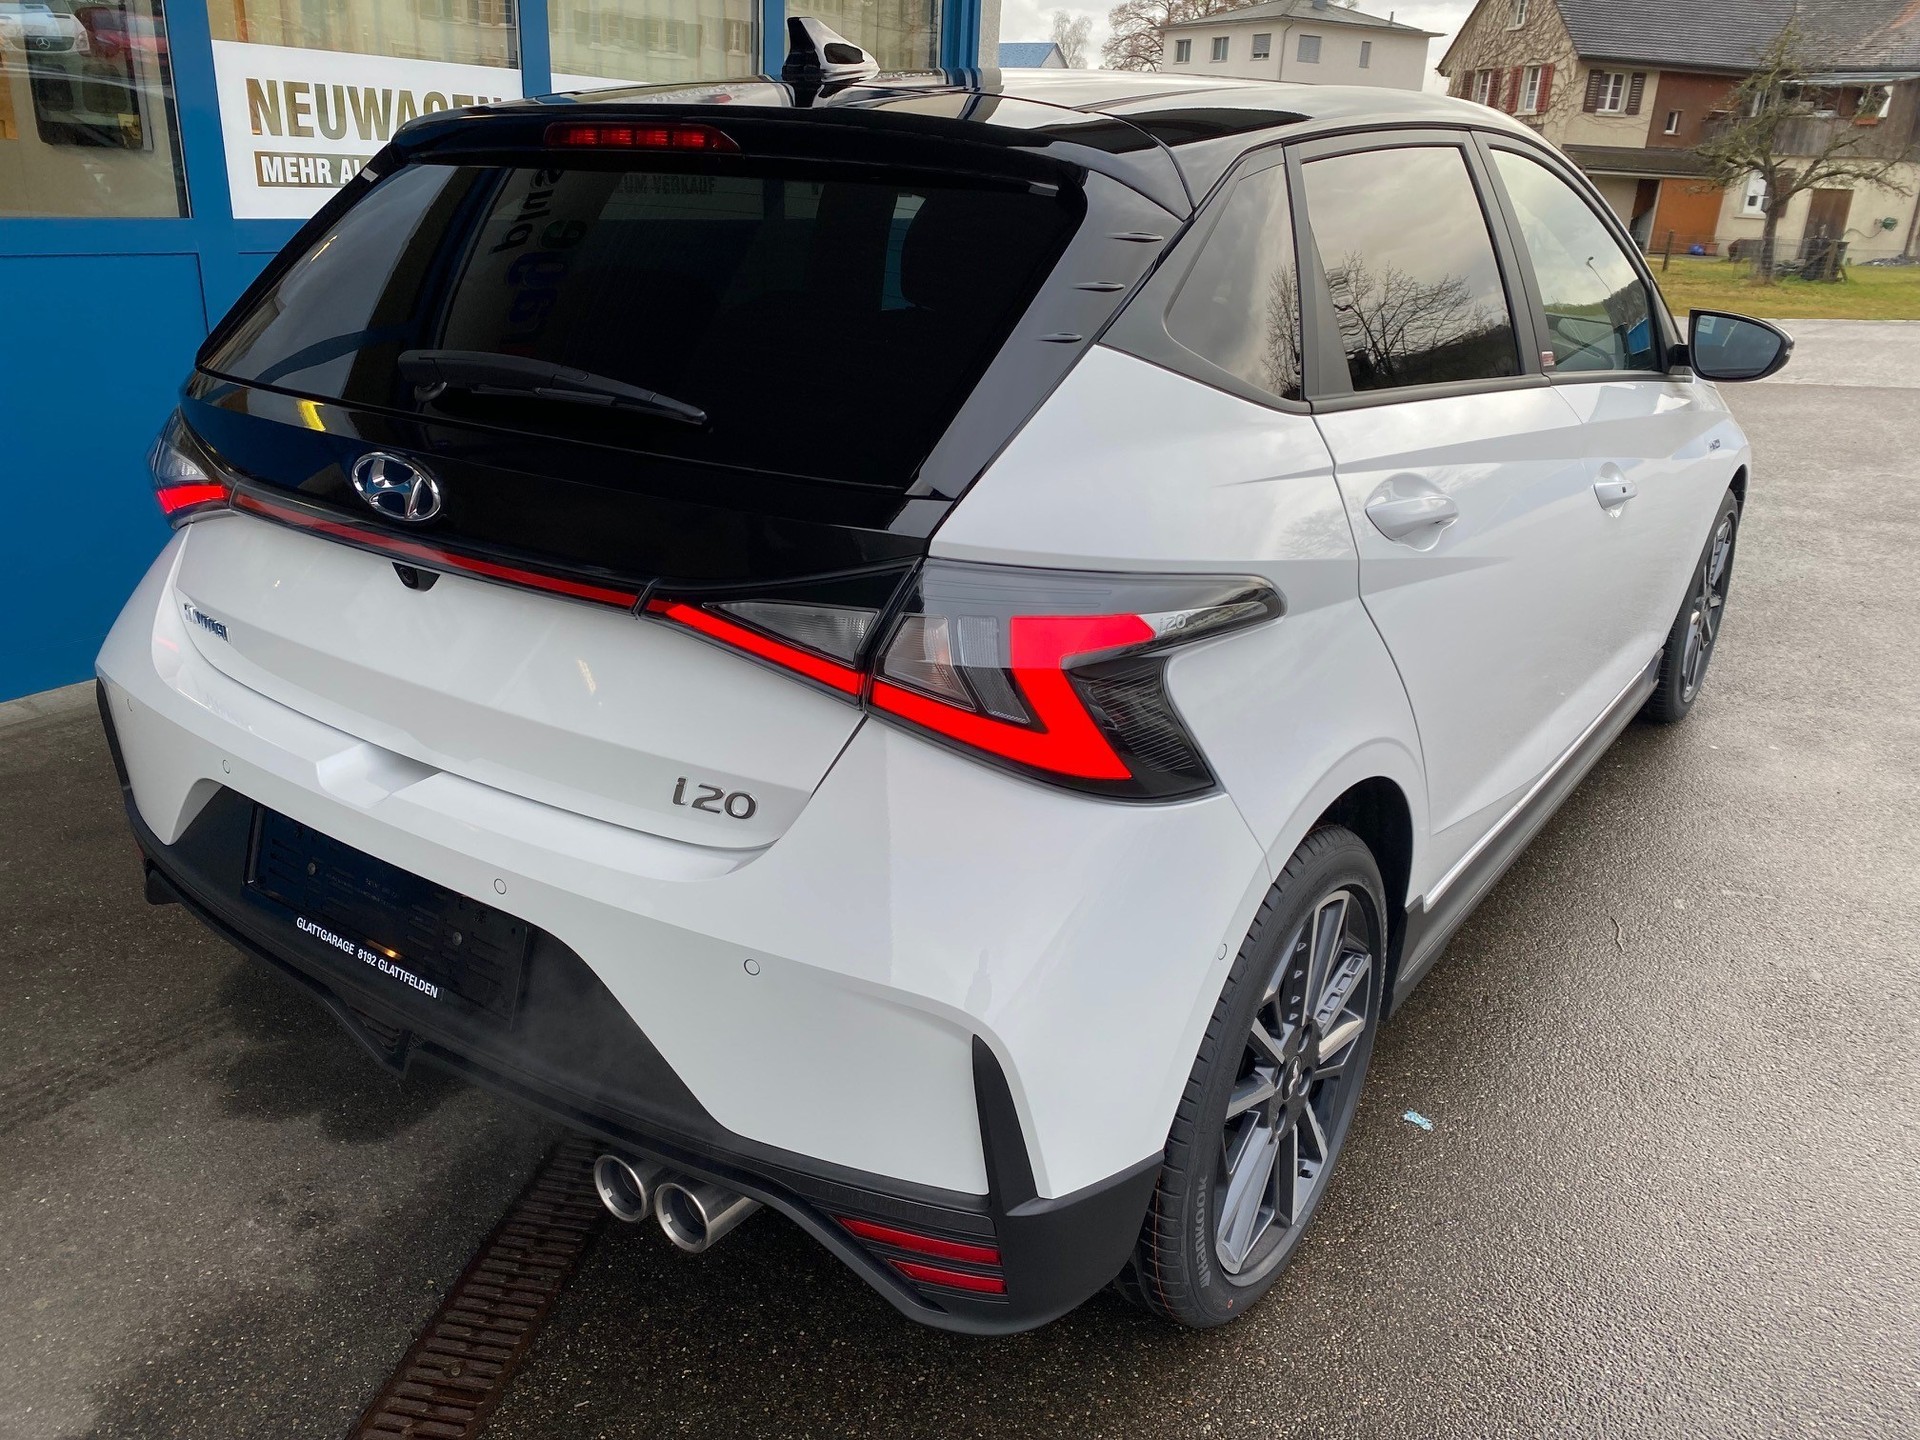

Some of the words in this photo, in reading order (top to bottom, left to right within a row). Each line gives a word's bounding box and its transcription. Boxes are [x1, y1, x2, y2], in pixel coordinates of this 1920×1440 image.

[246, 78, 502, 141] NEUWA
[261, 155, 332, 184] MEHR
[672, 776, 757, 820] i20
[296, 916, 355, 955] GLATTGARAGE
[357, 948, 378, 967] 8192
[377, 958, 438, 999] GLATTFELDEN
